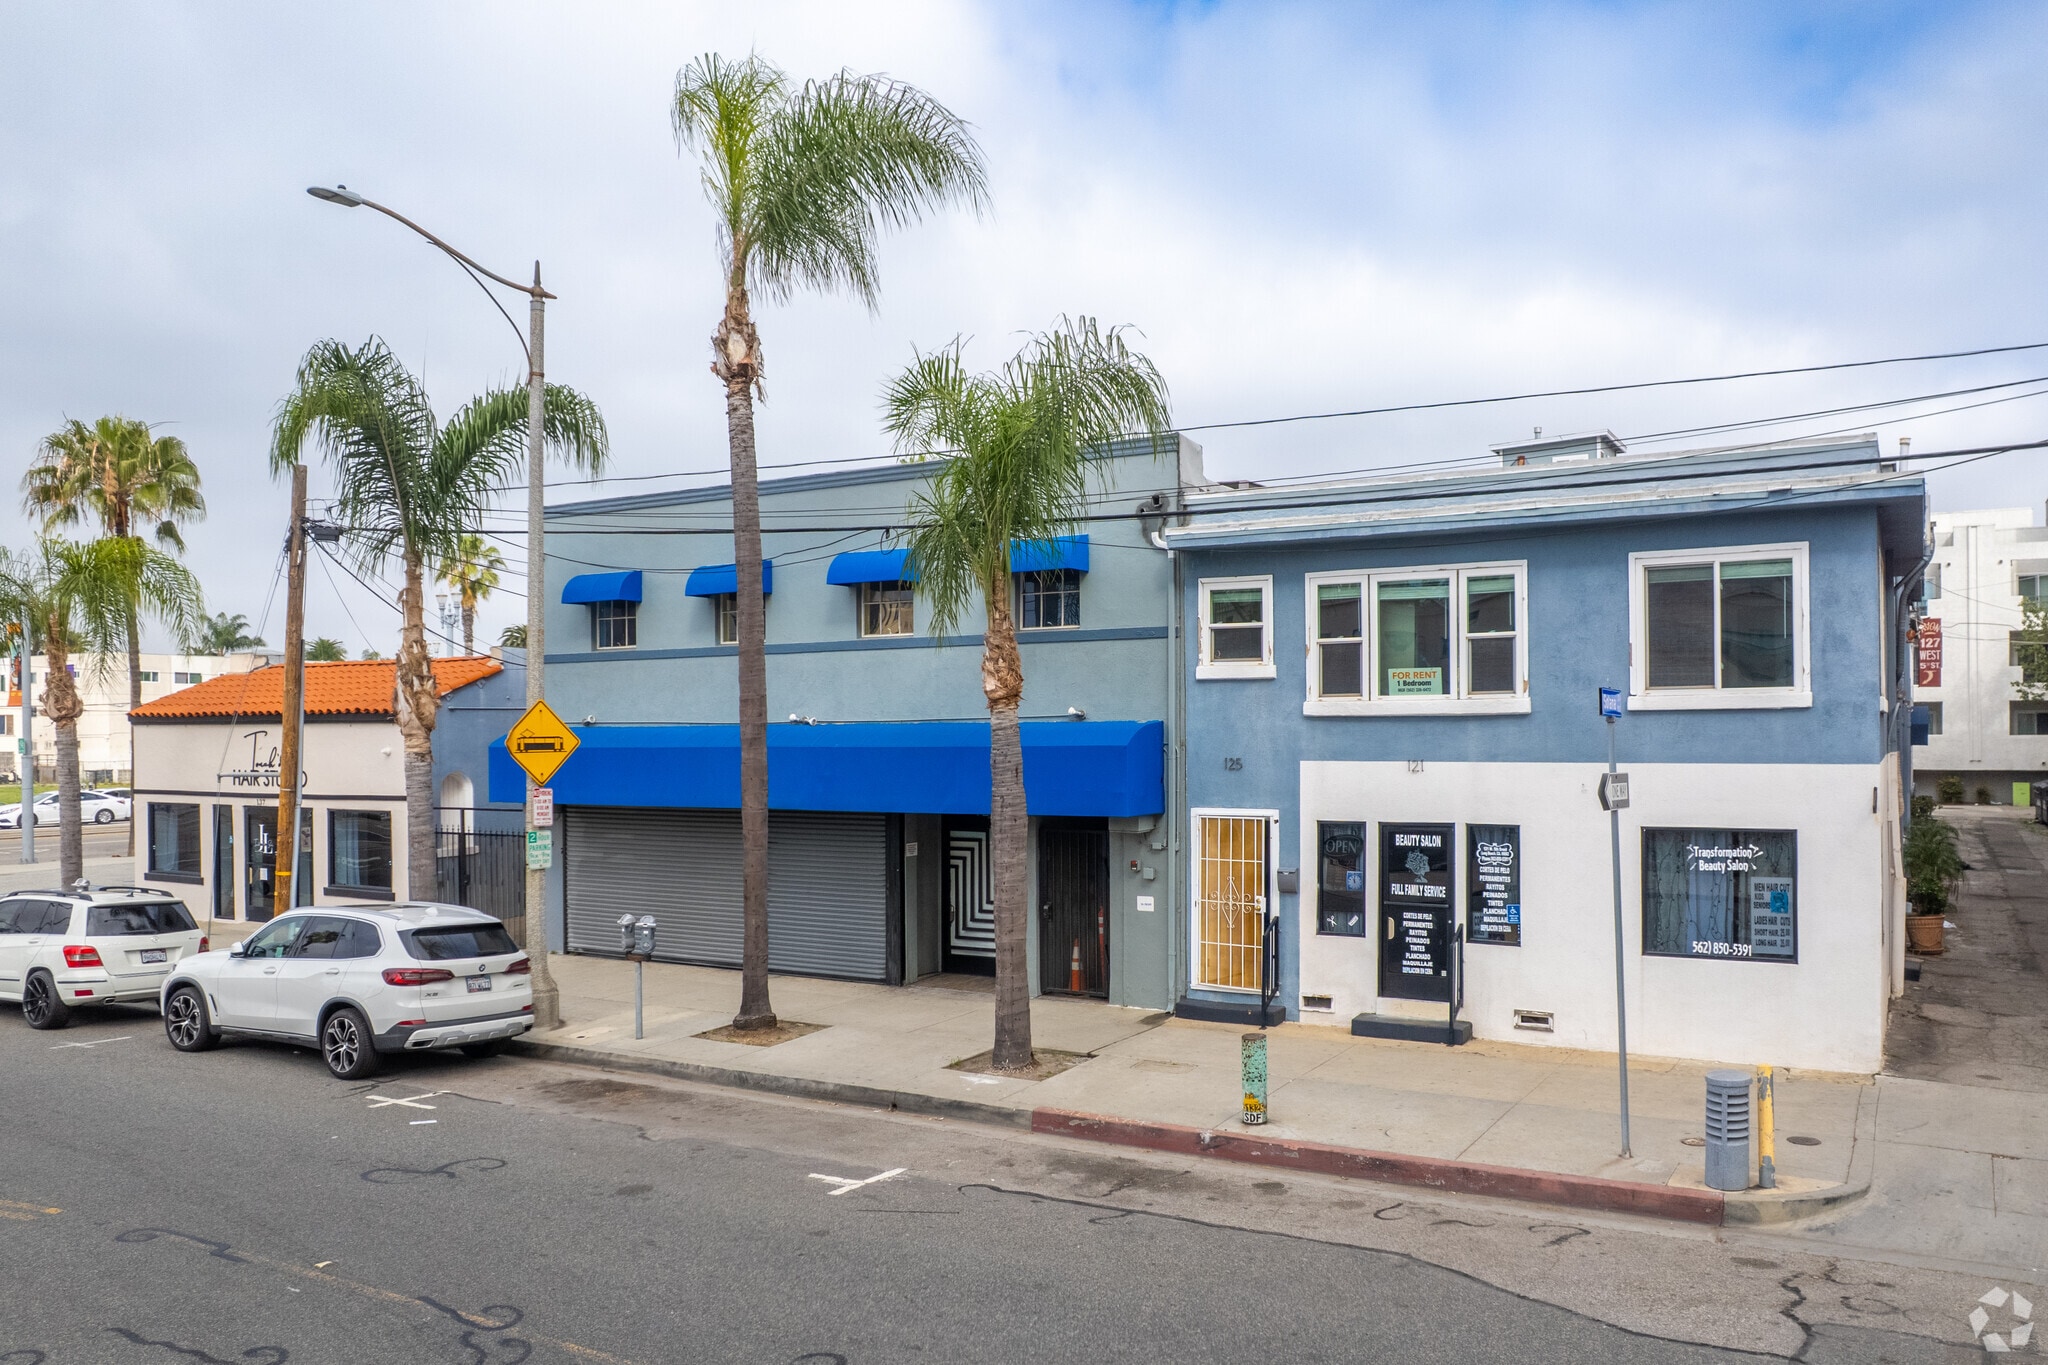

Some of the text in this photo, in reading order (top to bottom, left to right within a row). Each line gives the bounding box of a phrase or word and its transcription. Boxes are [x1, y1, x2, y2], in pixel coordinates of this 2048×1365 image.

[1920, 638, 1941, 648] 127
[1920, 650, 1941, 660] WEST
[1392, 671, 1437, 680] FOR RENT
[1224, 757, 1243, 771] 125
[1407, 759, 1424, 773] 121
[232, 769, 261, 787] HAIR
[529, 834, 536, 842] 2
[1395, 834, 1442, 848] BEAUTY SALON
[1325, 839, 1357, 854] OPEN
[1693, 846, 1752, 859] Transformation
[1699, 859, 1748, 874] Beauty Salon
[1479, 875, 1511, 883] PERMANENTES
[1391, 883, 1446, 898] FULL FAMILY SERVICE
[1486, 883, 1505, 891] RAYITOS
[1754, 883, 1790, 893] MEN HAIR CUT
[1482, 891, 1508, 899] PEINADOS
[1754, 892, 1765, 900] KIDS
[1417, 912, 1423, 920] DE
[1402, 920, 1434, 929] PERMANENTES
[1768, 916, 1778, 926] HAIR
[1409, 929, 1428, 937] RAYITOS
[1754, 928, 1768, 936] SHORT
[1405, 936, 1431, 945] PEINADOS
[1755, 938, 1767, 947] LONG
[1410, 944, 1426, 952] TINTES
[1692, 941, 1752, 957] 562) 850-5391
[1405, 952, 1431, 960] PLANCHADO
[1244, 1113, 1262, 1123] SDF
